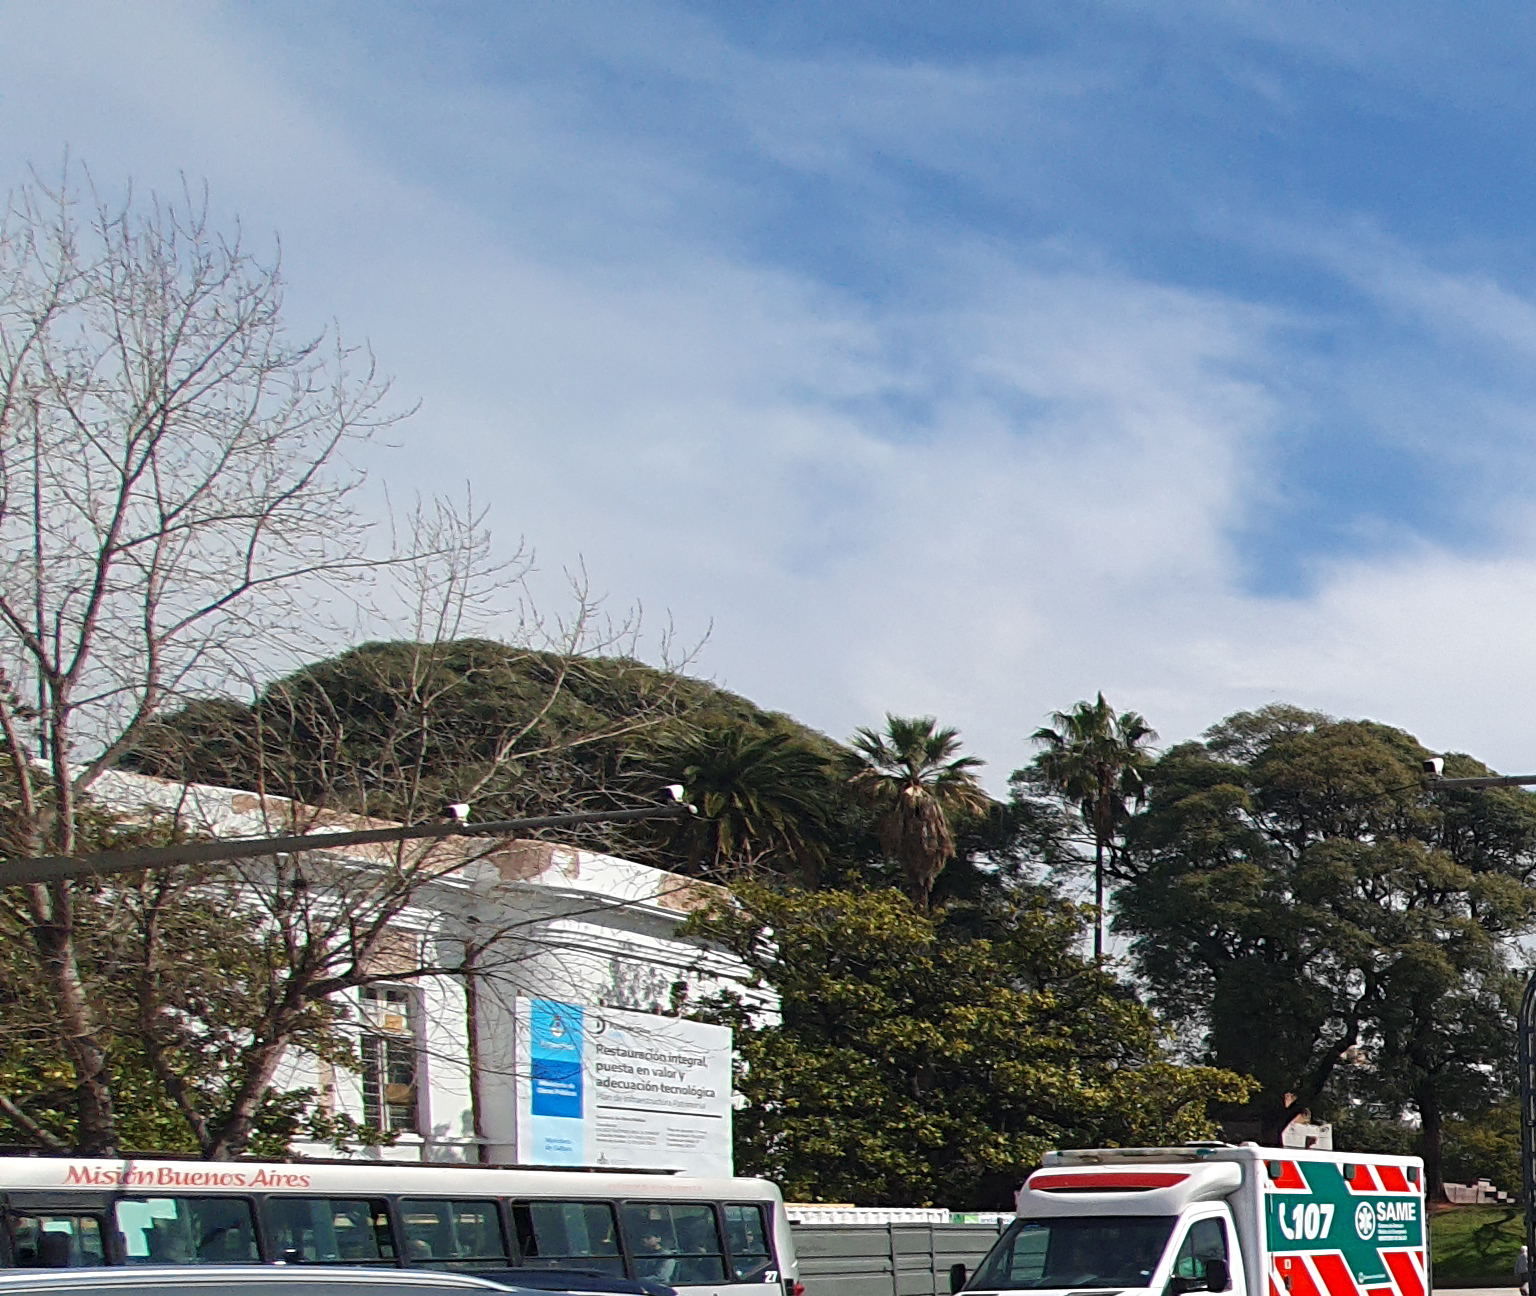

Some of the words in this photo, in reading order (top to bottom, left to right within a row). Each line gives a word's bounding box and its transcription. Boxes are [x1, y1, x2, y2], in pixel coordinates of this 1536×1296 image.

[596, 1062, 634, 1075] puesta
[637, 1067, 650, 1076] en
[652, 1067, 677, 1078] valor
[678, 1072, 686, 1082] y
[596, 1077, 658, 1092] adecuación
[660, 1082, 715, 1099] tecnológica
[157, 1167, 246, 1187] Buenos
[249, 1168, 311, 1188] Aires
[1376, 1201, 1416, 1221] SAME
[1292, 1203, 1335, 1240] 107
[764, 1270, 778, 1283] 27
